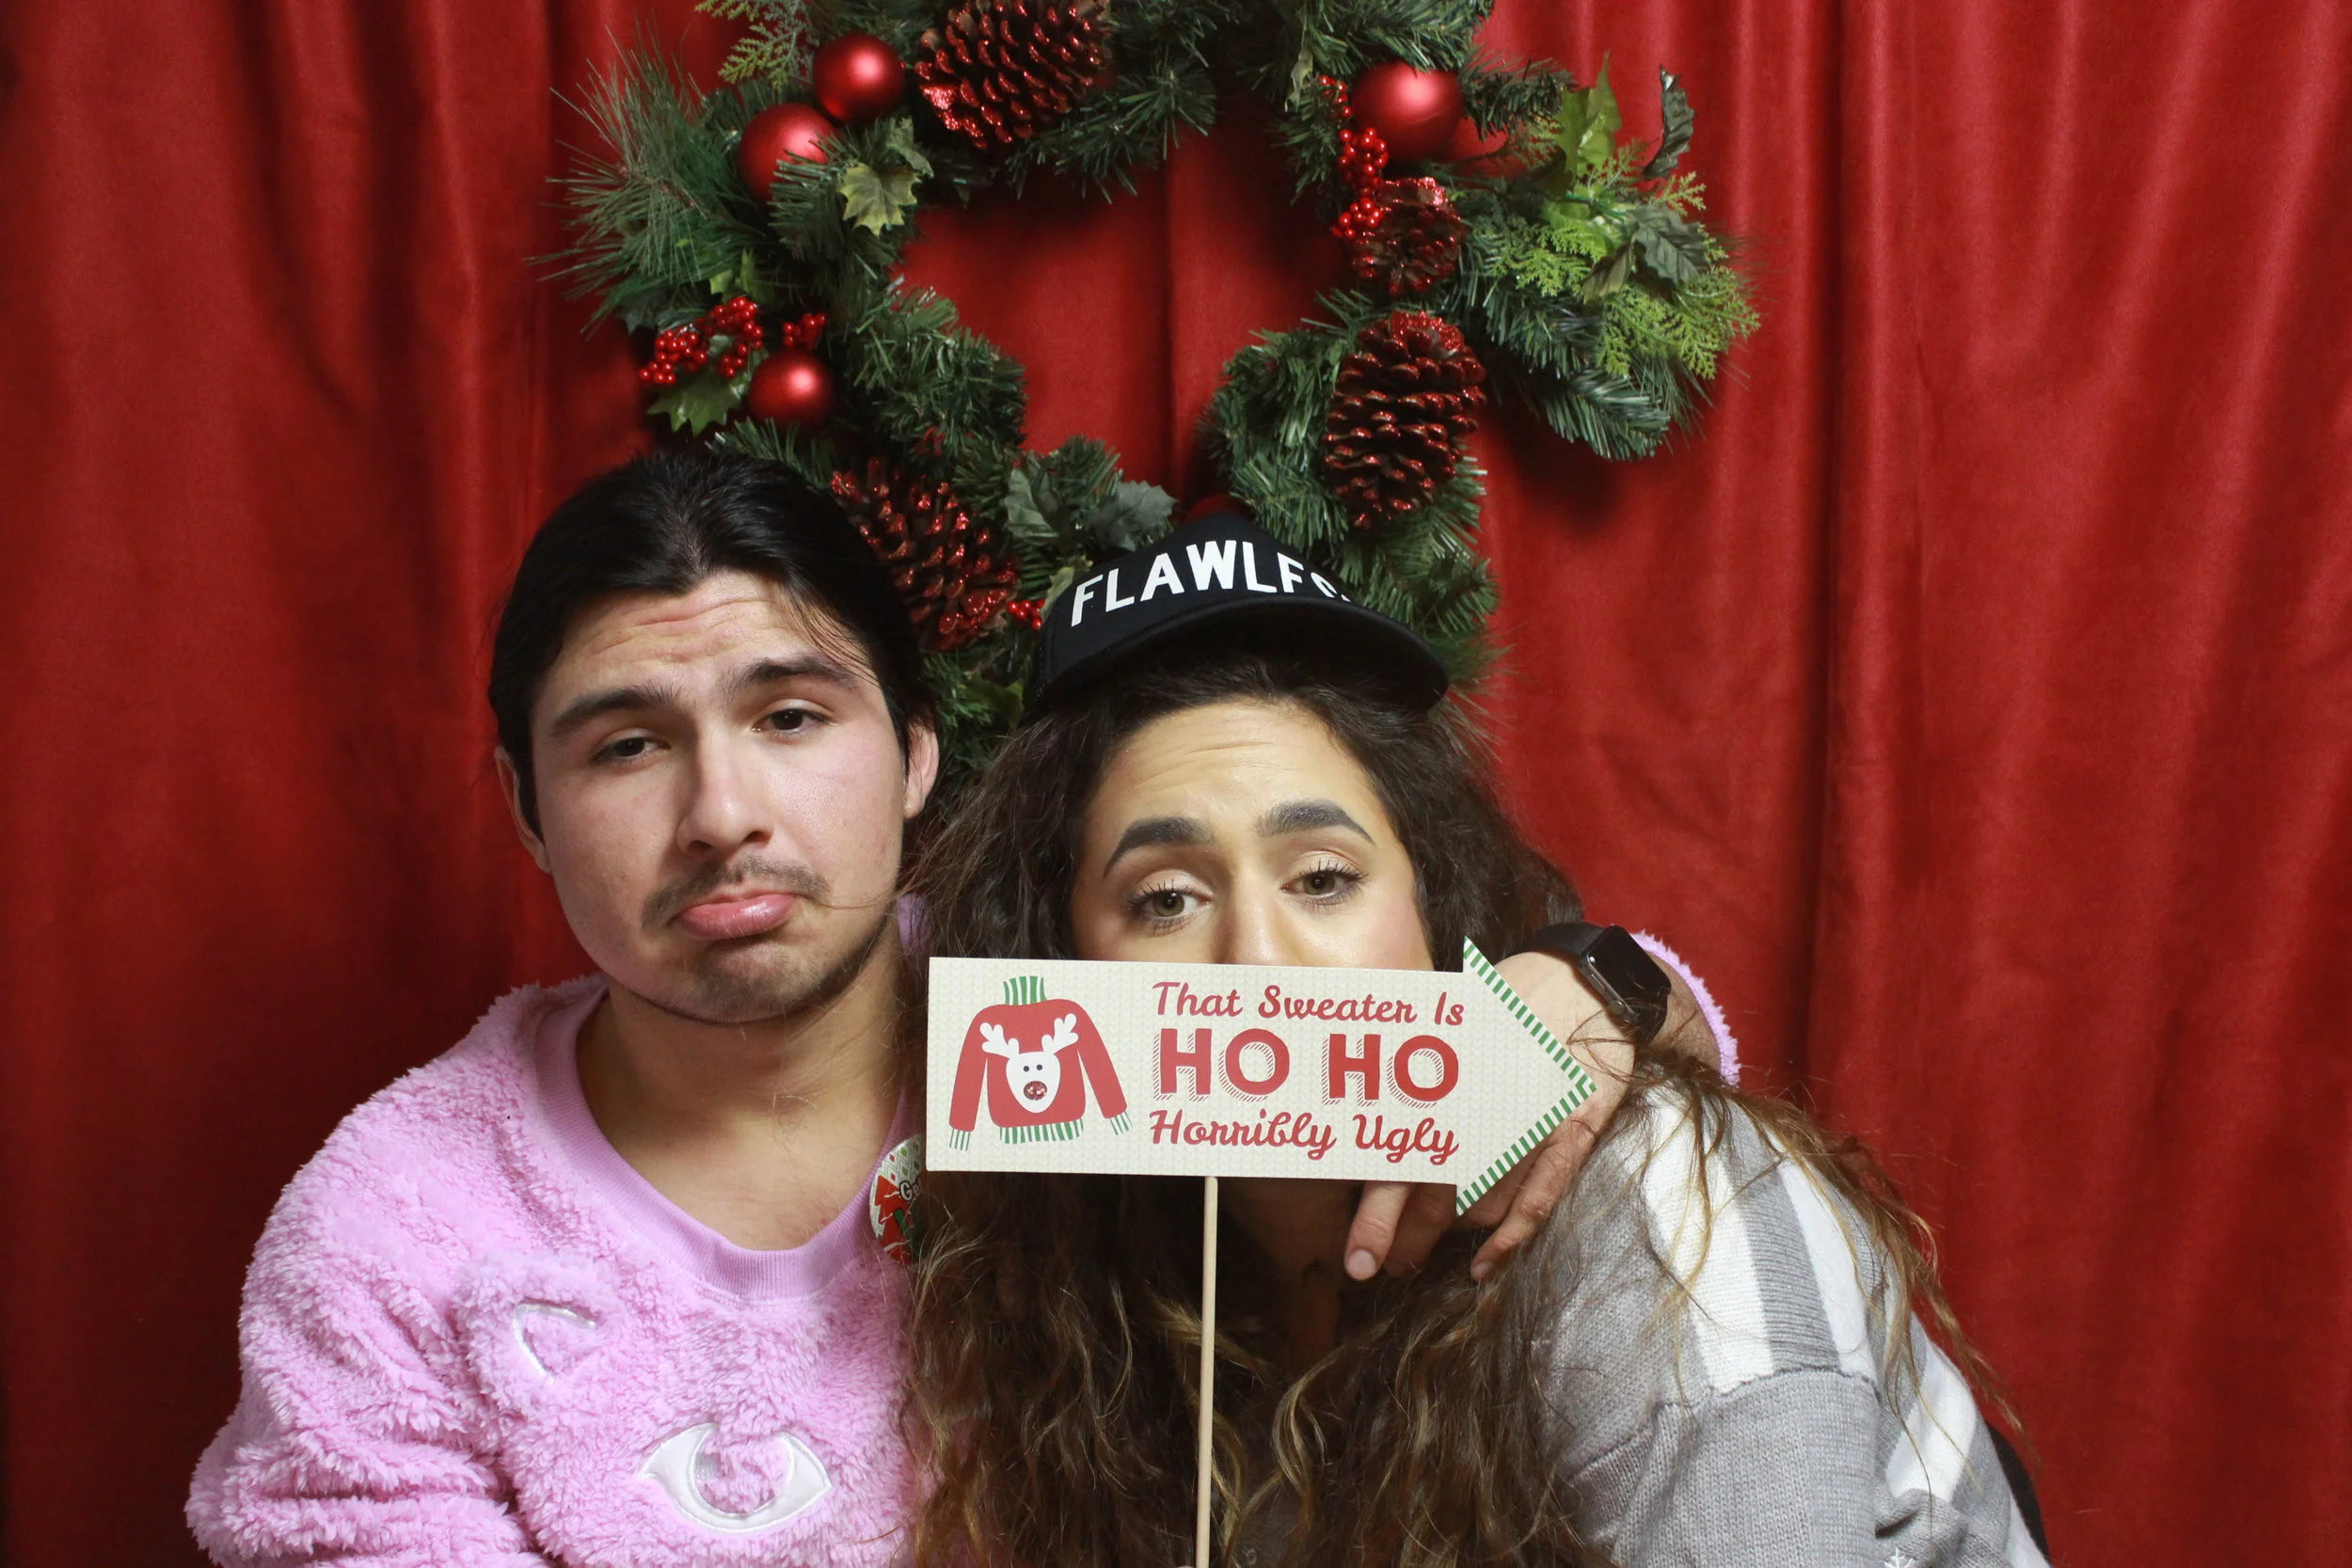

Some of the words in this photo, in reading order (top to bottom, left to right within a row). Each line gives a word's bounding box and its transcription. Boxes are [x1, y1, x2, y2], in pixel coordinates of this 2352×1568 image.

[1071, 540, 1351, 626] FLAWLE
[1152, 981, 1244, 1017] That
[1258, 985, 1417, 1023] Sweater
[1434, 991, 1465, 1026] Is
[1152, 1028, 1290, 1102] HO
[1321, 1033, 1459, 1108] HO
[1149, 1108, 1337, 1161] Horribly
[1352, 1114, 1460, 1165] Ugly
